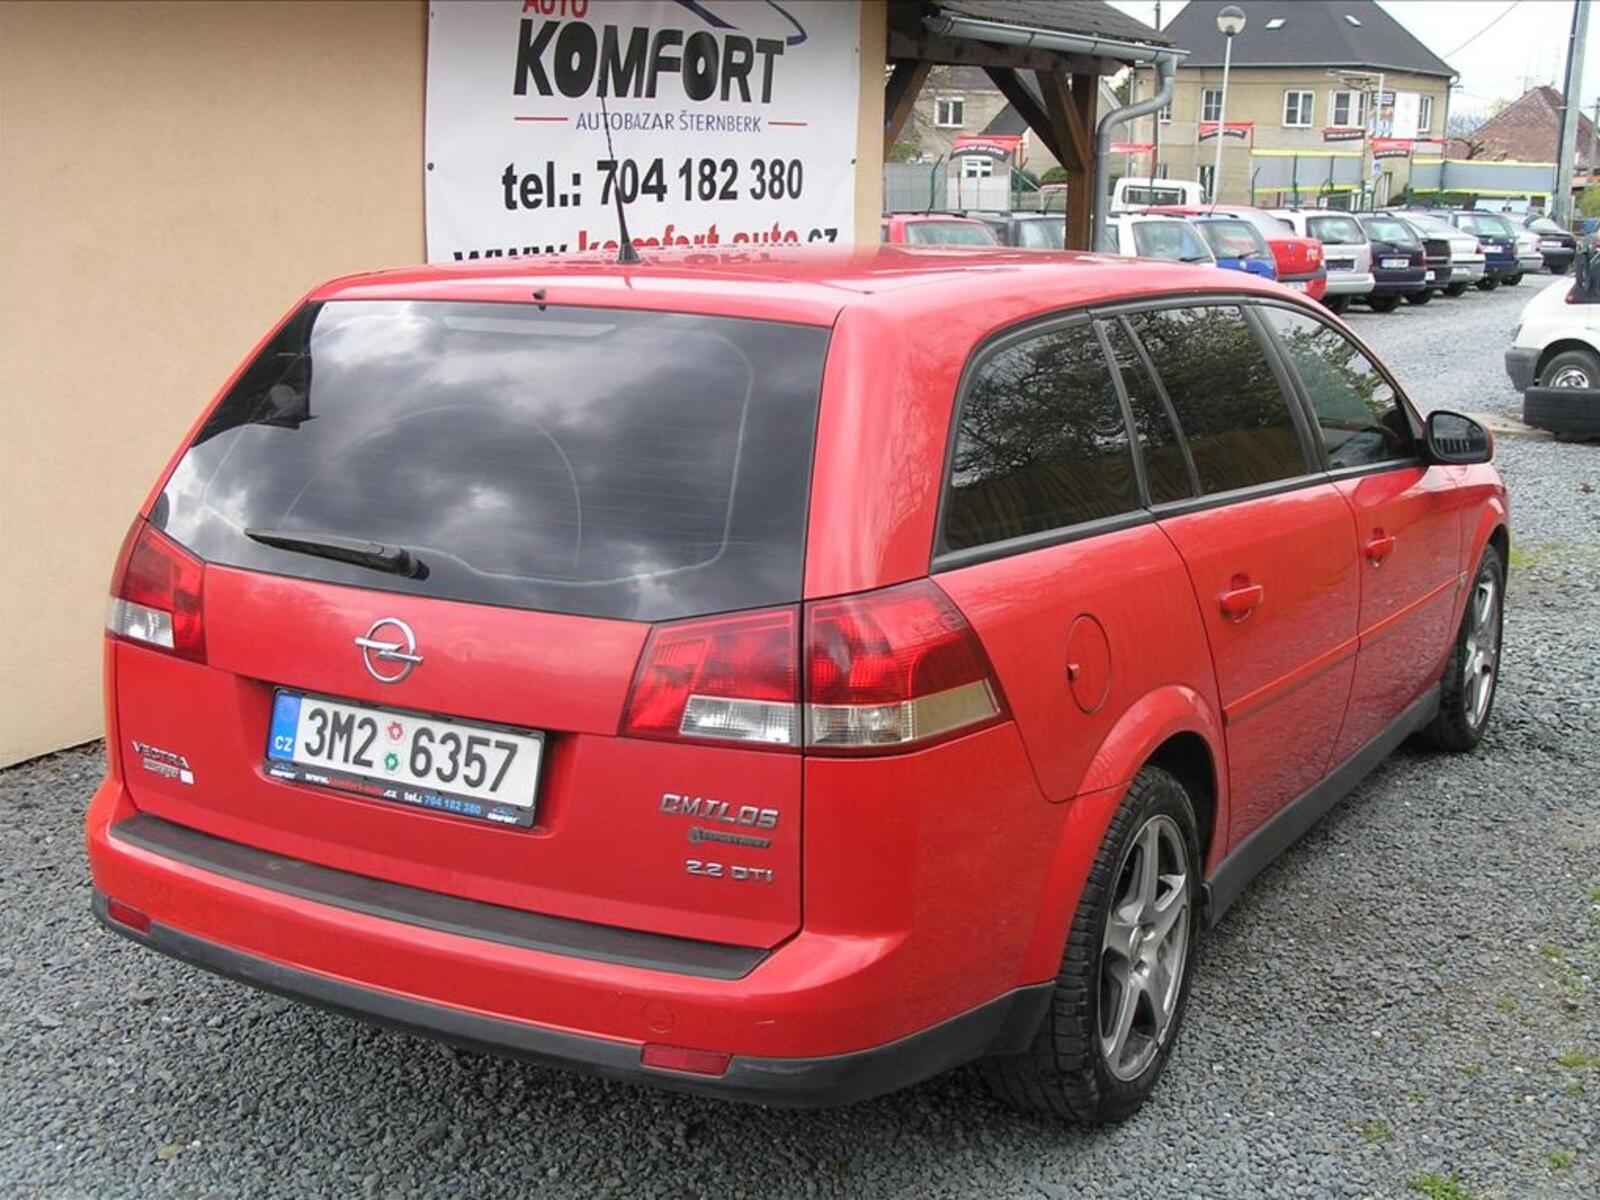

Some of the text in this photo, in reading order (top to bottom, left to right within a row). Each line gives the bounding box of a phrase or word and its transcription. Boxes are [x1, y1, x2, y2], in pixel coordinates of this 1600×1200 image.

[513, 19, 785, 104] KOMFORT
[575, 110, 761, 133] AUTOBAZAR ŠTERNBERK
[502, 158, 803, 210] tel.: 704 182 380
[275, 736, 294, 751] CZ
[305, 708, 378, 768] 3M2
[410, 727, 519, 793] 6357
